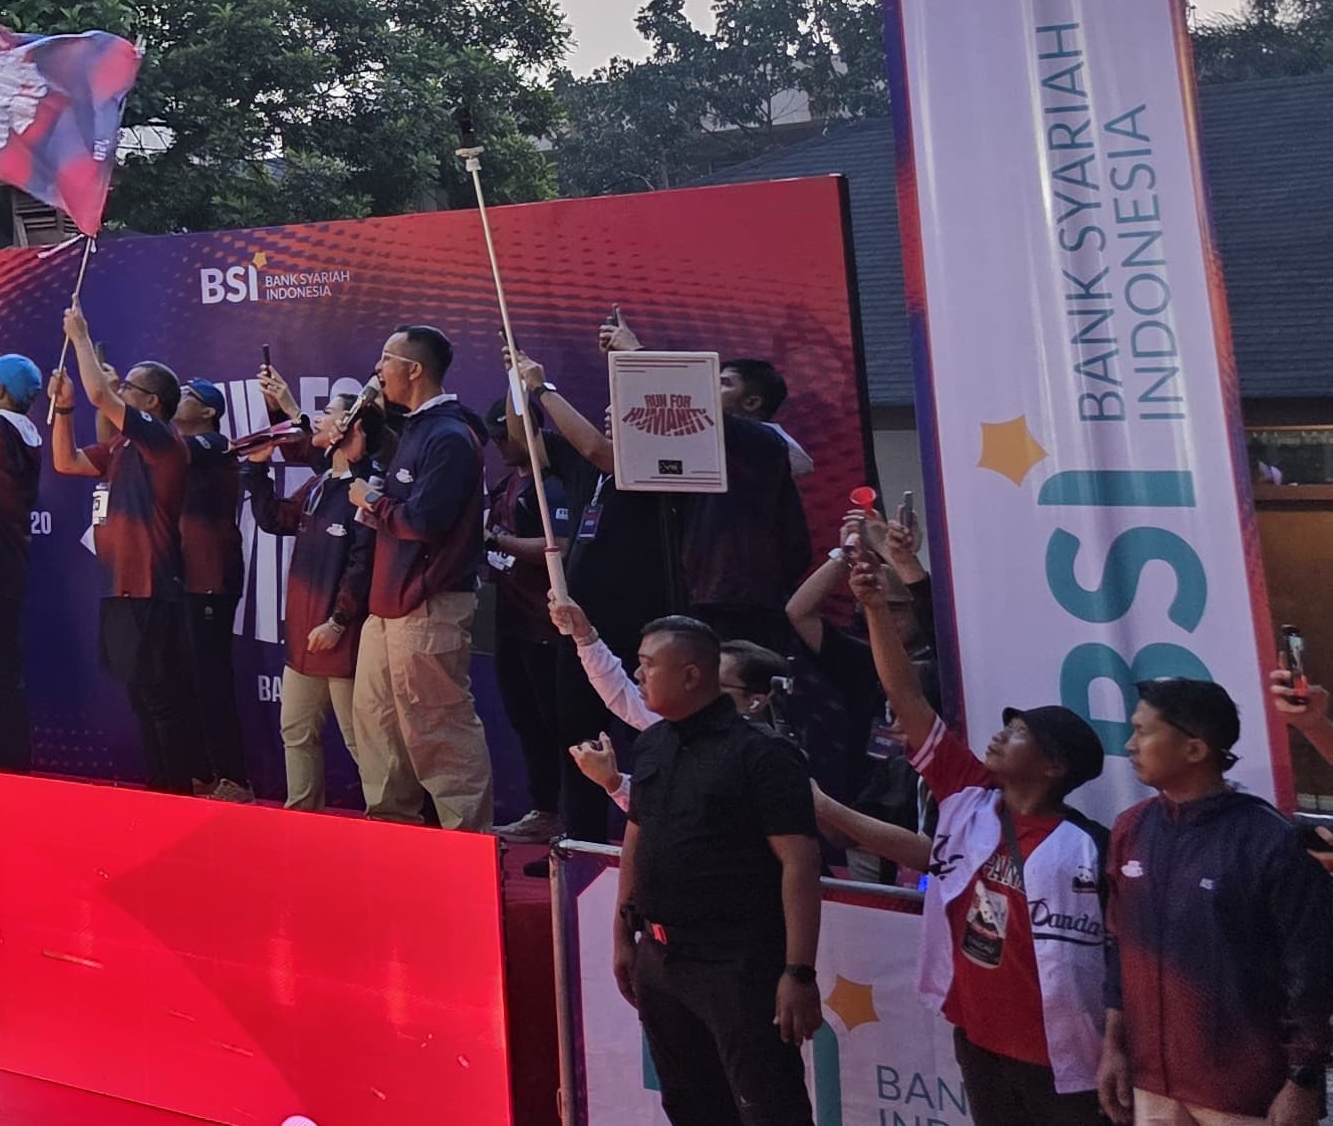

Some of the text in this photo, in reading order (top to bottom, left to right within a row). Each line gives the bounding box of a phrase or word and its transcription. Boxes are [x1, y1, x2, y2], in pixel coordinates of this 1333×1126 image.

[1035, 21, 1125, 423] BANK SYARIAH
[1104, 104, 1185, 422] INDONESIA
[200, 265, 350, 304] BSI BANK SYARIAH
[266, 285, 332, 301] INDONESIA
[645, 394, 691, 408] RUN FOR
[622, 407, 714, 436] HUMANITY
[876, 1064, 967, 1116] BAN
